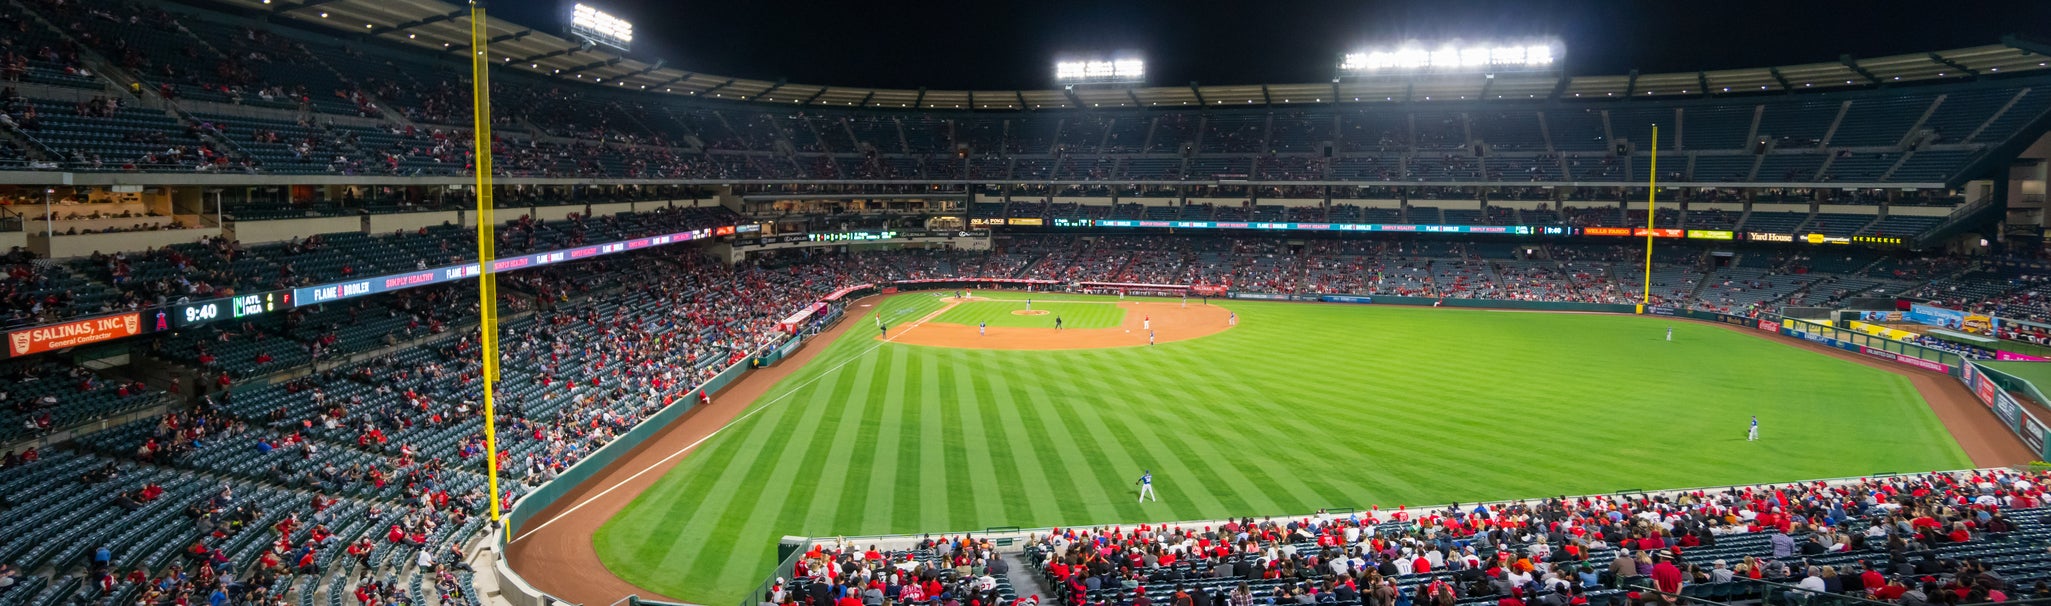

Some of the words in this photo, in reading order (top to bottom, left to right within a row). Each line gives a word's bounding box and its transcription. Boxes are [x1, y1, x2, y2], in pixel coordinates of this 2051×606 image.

[1750, 232, 1768, 241] Yard
[1768, 233, 1792, 242] House
[446, 265, 462, 280] FLAME
[386, 277, 408, 289] SIMPLY
[408, 273, 434, 285] HEALTHY
[266, 293, 273, 302] 4
[314, 287, 337, 301] FLAME
[343, 281, 370, 297] BROILER
[245, 294, 261, 306] ATL
[284, 294, 289, 304] F
[185, 303, 217, 322] 9:40
[246, 304, 262, 315] MIA
[33, 321, 95, 342] SALINAS,
[97, 317, 124, 332] INC.
[49, 338, 76, 349] General
[77, 332, 112, 344] Contractor
[979, 583, 991, 591] 27
